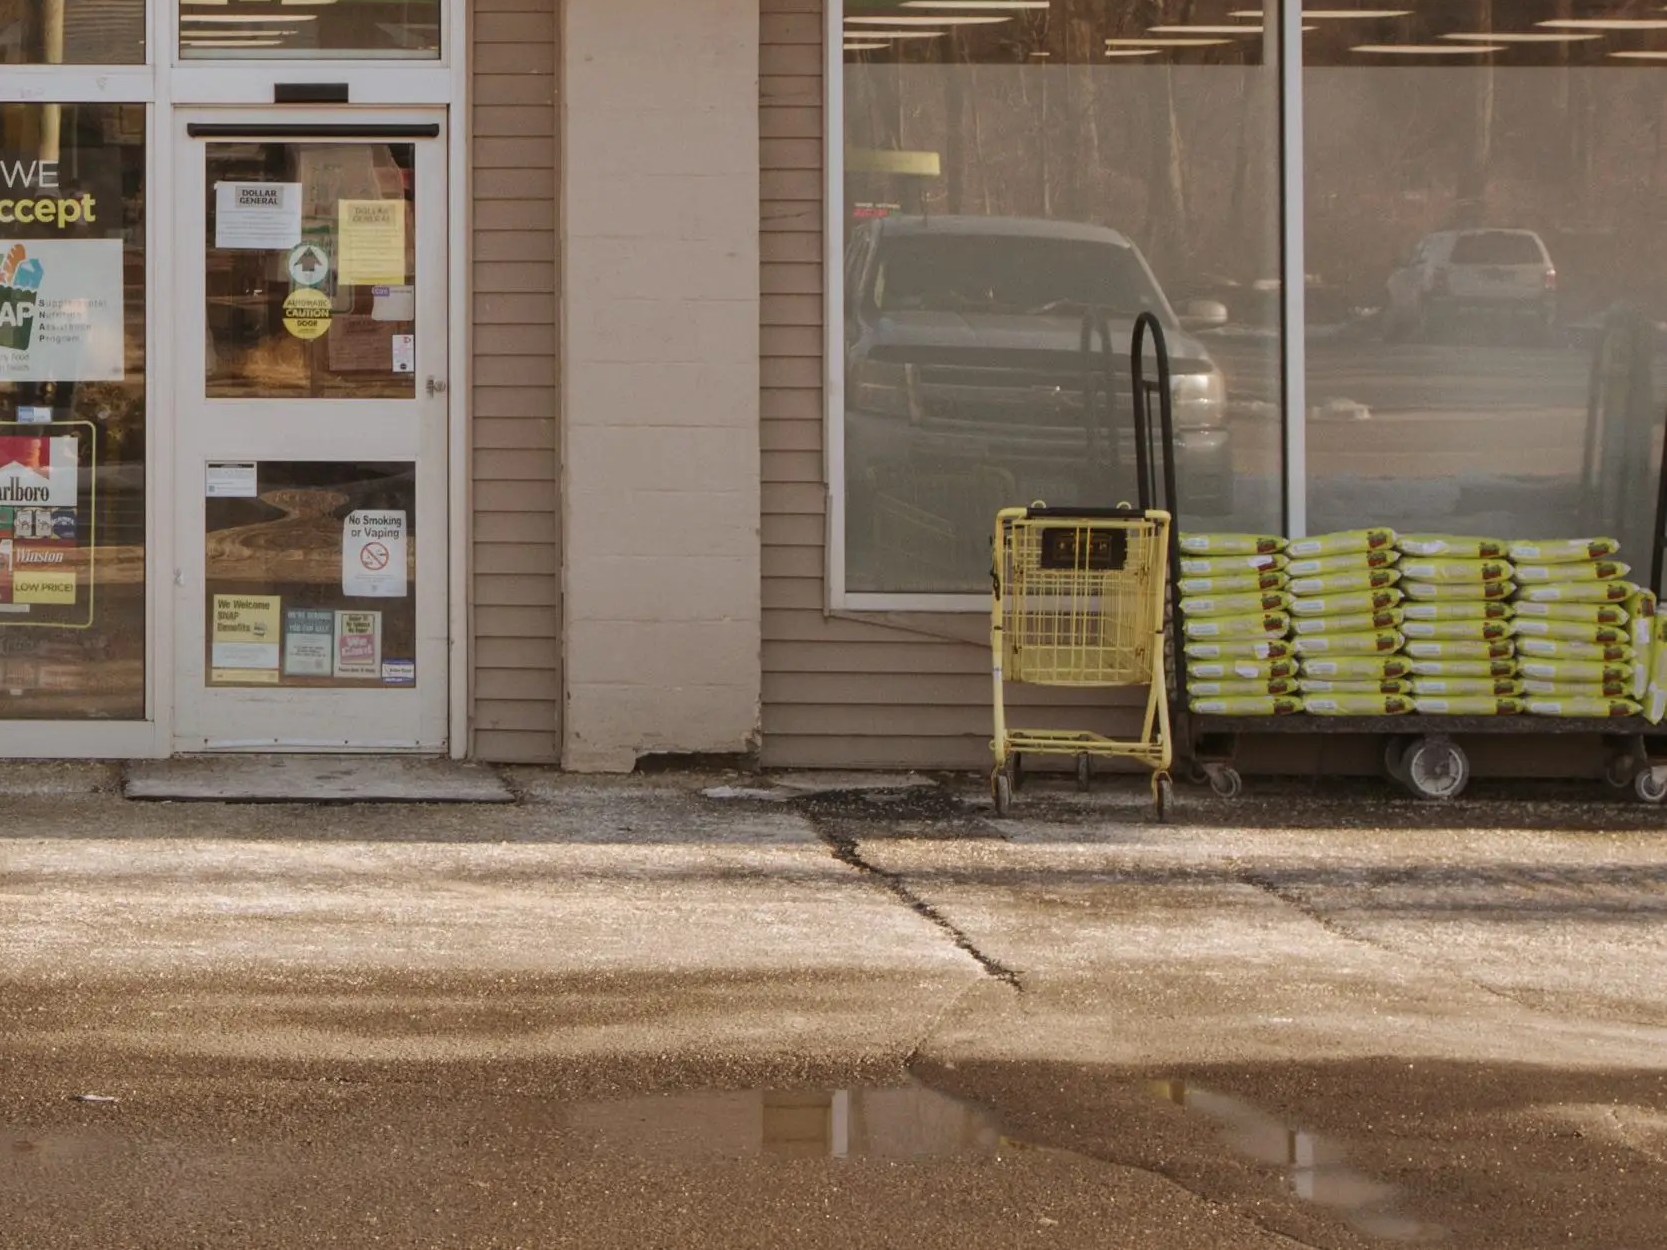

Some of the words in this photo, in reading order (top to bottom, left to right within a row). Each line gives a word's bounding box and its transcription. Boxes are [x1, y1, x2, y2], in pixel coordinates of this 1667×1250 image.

[0, 160, 59, 188] WE
[242, 189, 277, 197] DOLLAR
[239, 197, 278, 205] GENERAL
[285, 309, 329, 318] CAUTION
[348, 515, 361, 525] No
[363, 515, 402, 528] Smoking
[351, 529, 362, 538] or
[364, 527, 400, 540] Vaping
[16, 548, 65, 563] Winston
[15, 583, 39, 592] LOW
[42, 583, 73, 592] PRICE!
[217, 599, 231, 609] We
[233, 599, 271, 610] Welcome
